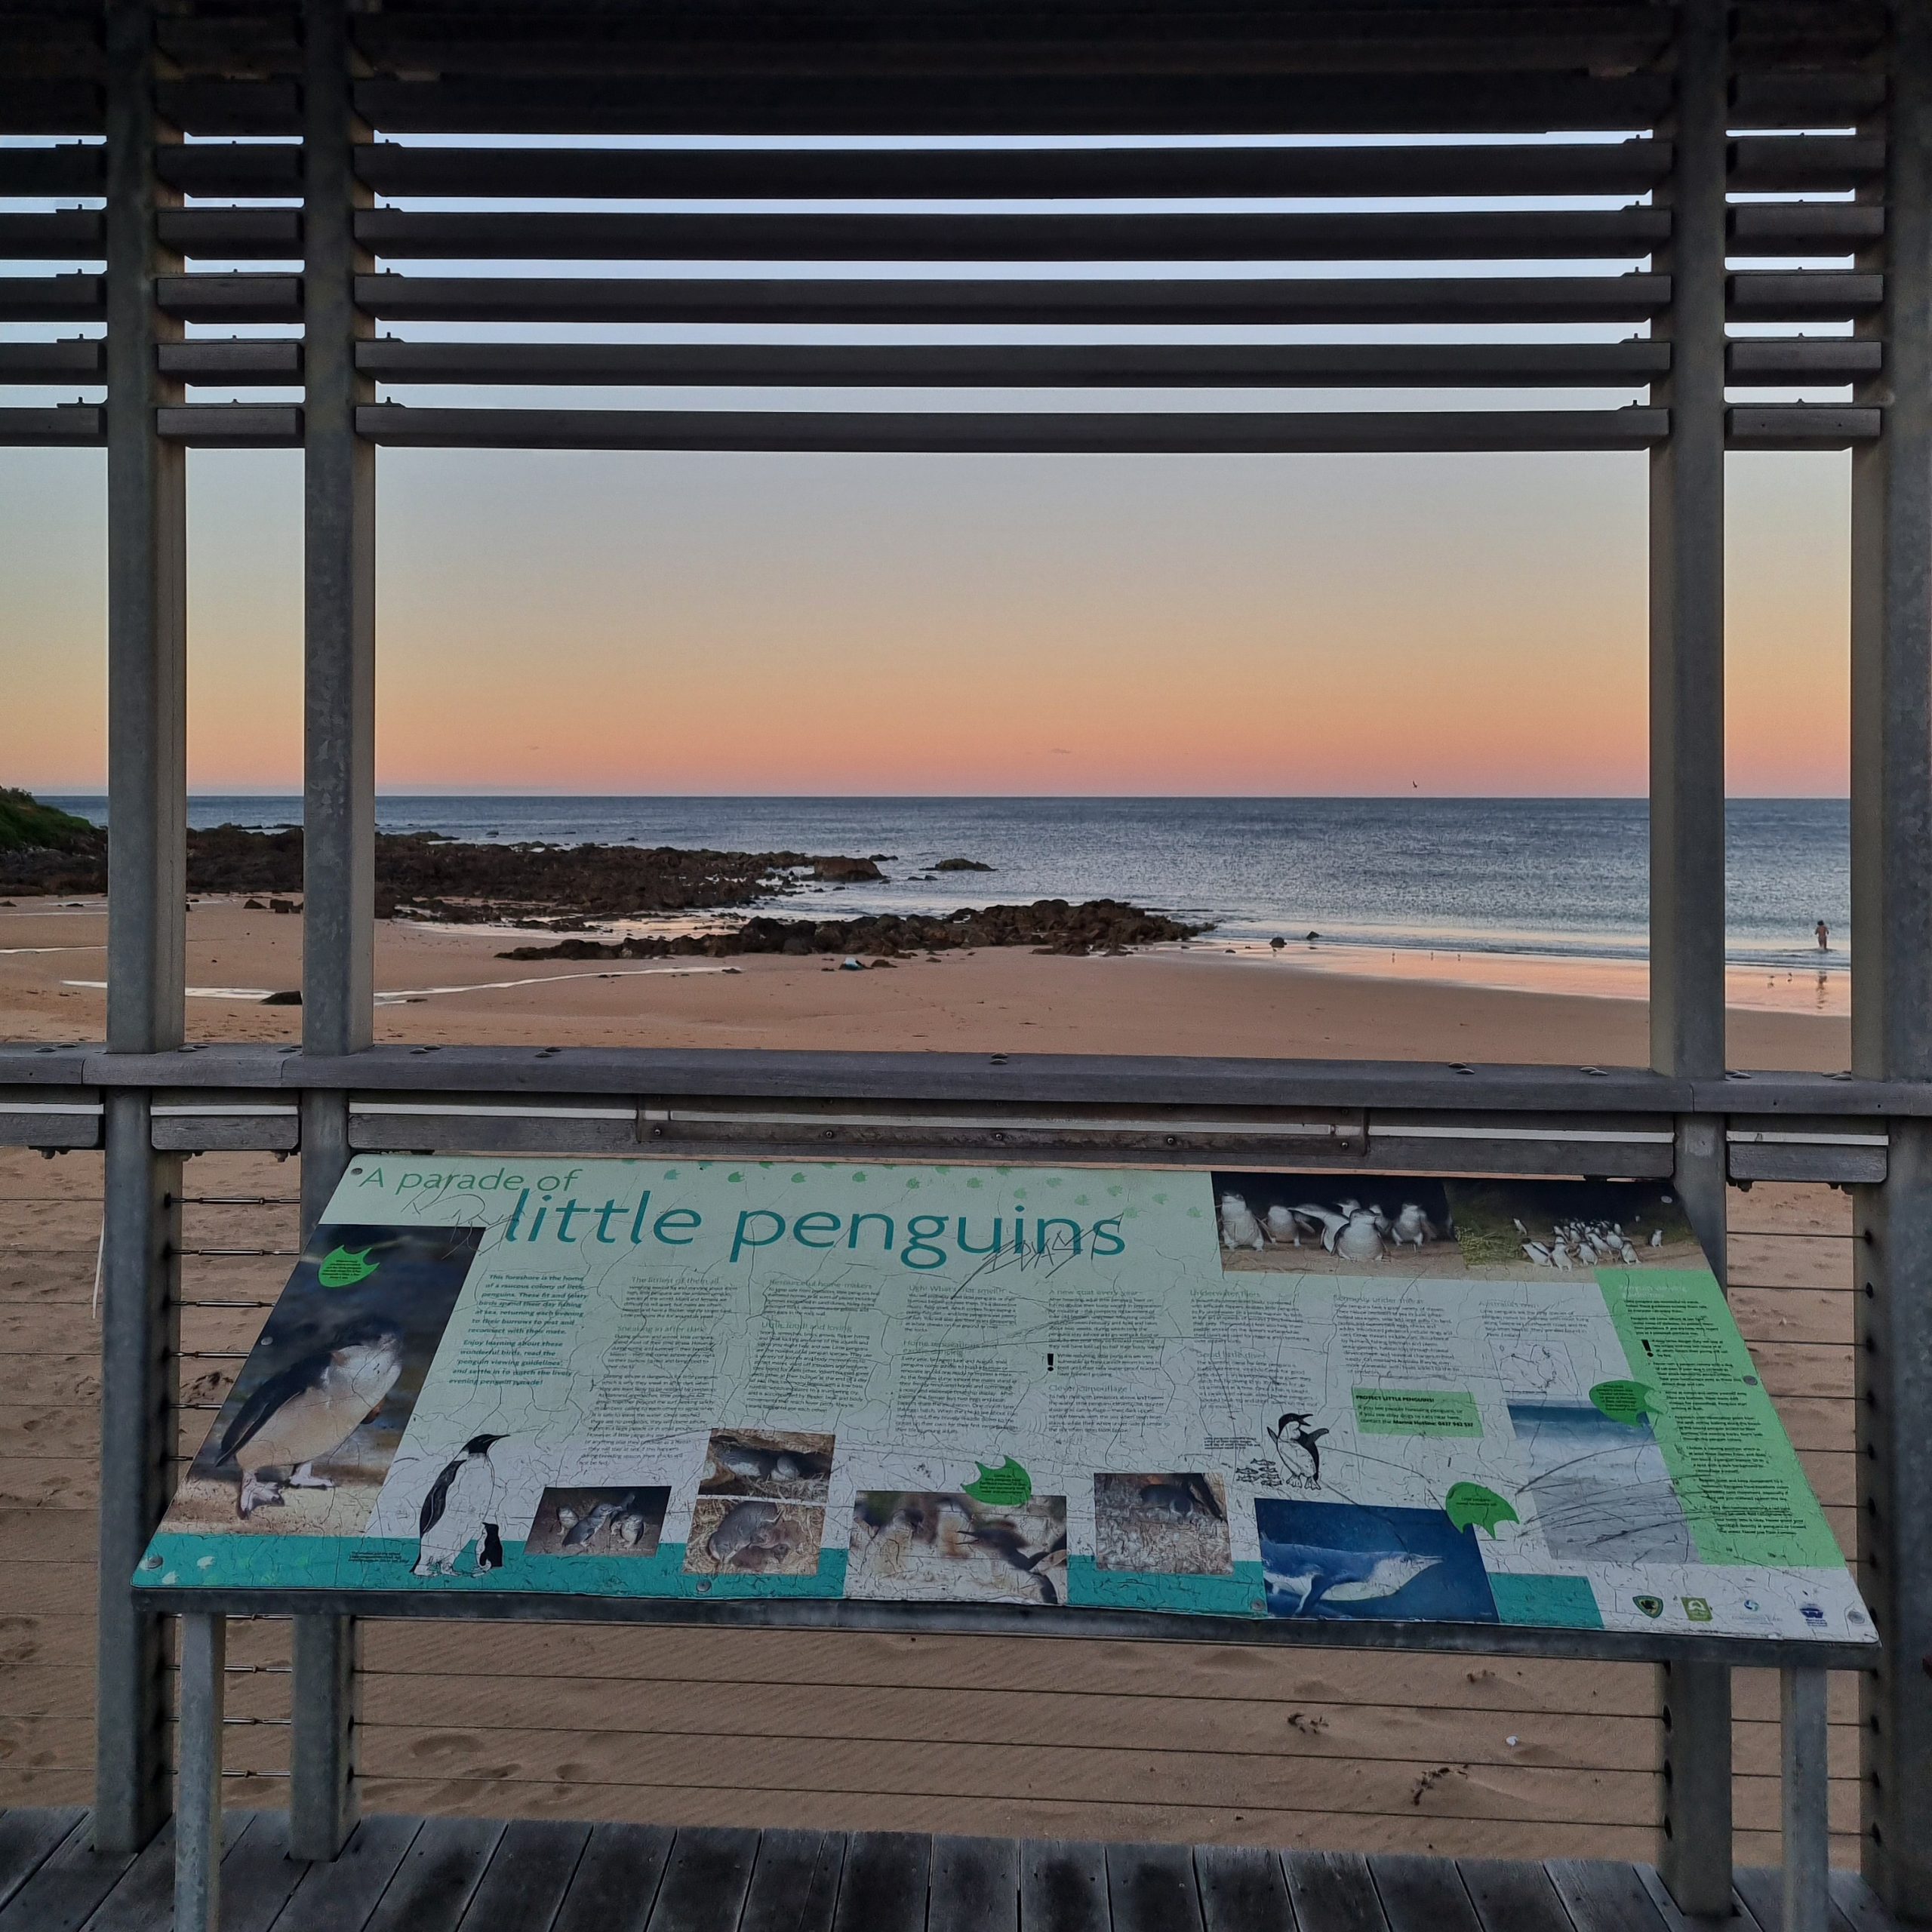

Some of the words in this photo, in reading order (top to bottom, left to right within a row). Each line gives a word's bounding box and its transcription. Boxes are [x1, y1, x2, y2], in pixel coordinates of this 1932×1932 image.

[358, 1167, 384, 1188] A
[395, 1167, 525, 1195] parade
[537, 1168, 583, 1192] of
[505, 1188, 702, 1244] little
[729, 1204, 1126, 1269] penguins
